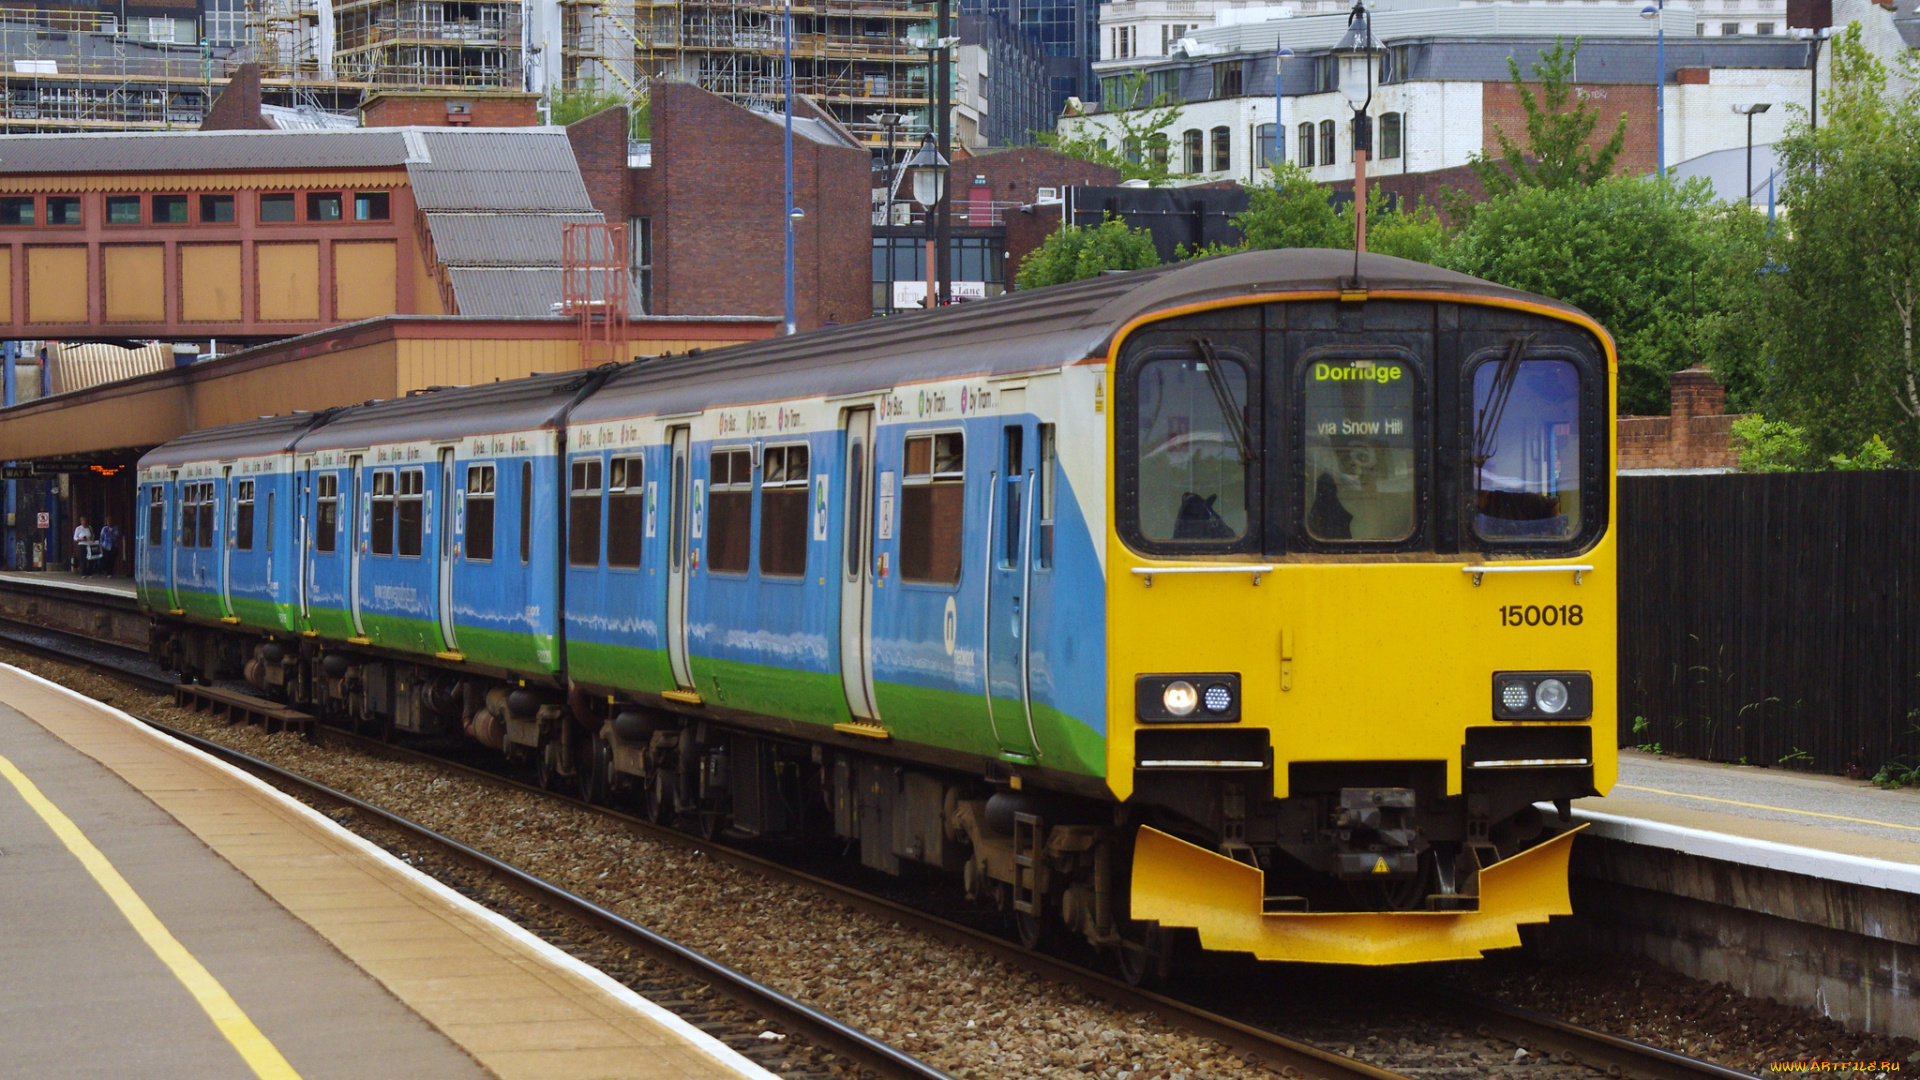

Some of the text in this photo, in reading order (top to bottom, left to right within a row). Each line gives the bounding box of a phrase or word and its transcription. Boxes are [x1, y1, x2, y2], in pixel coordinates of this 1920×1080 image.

[1315, 363, 1402, 384] Dorridge
[926, 390, 933, 419] by
[969, 386, 977, 415] by
[1317, 419, 1403, 435] via Snow Hill
[6, 469, 24, 478] WAY
[1499, 604, 1583, 626] 150018
